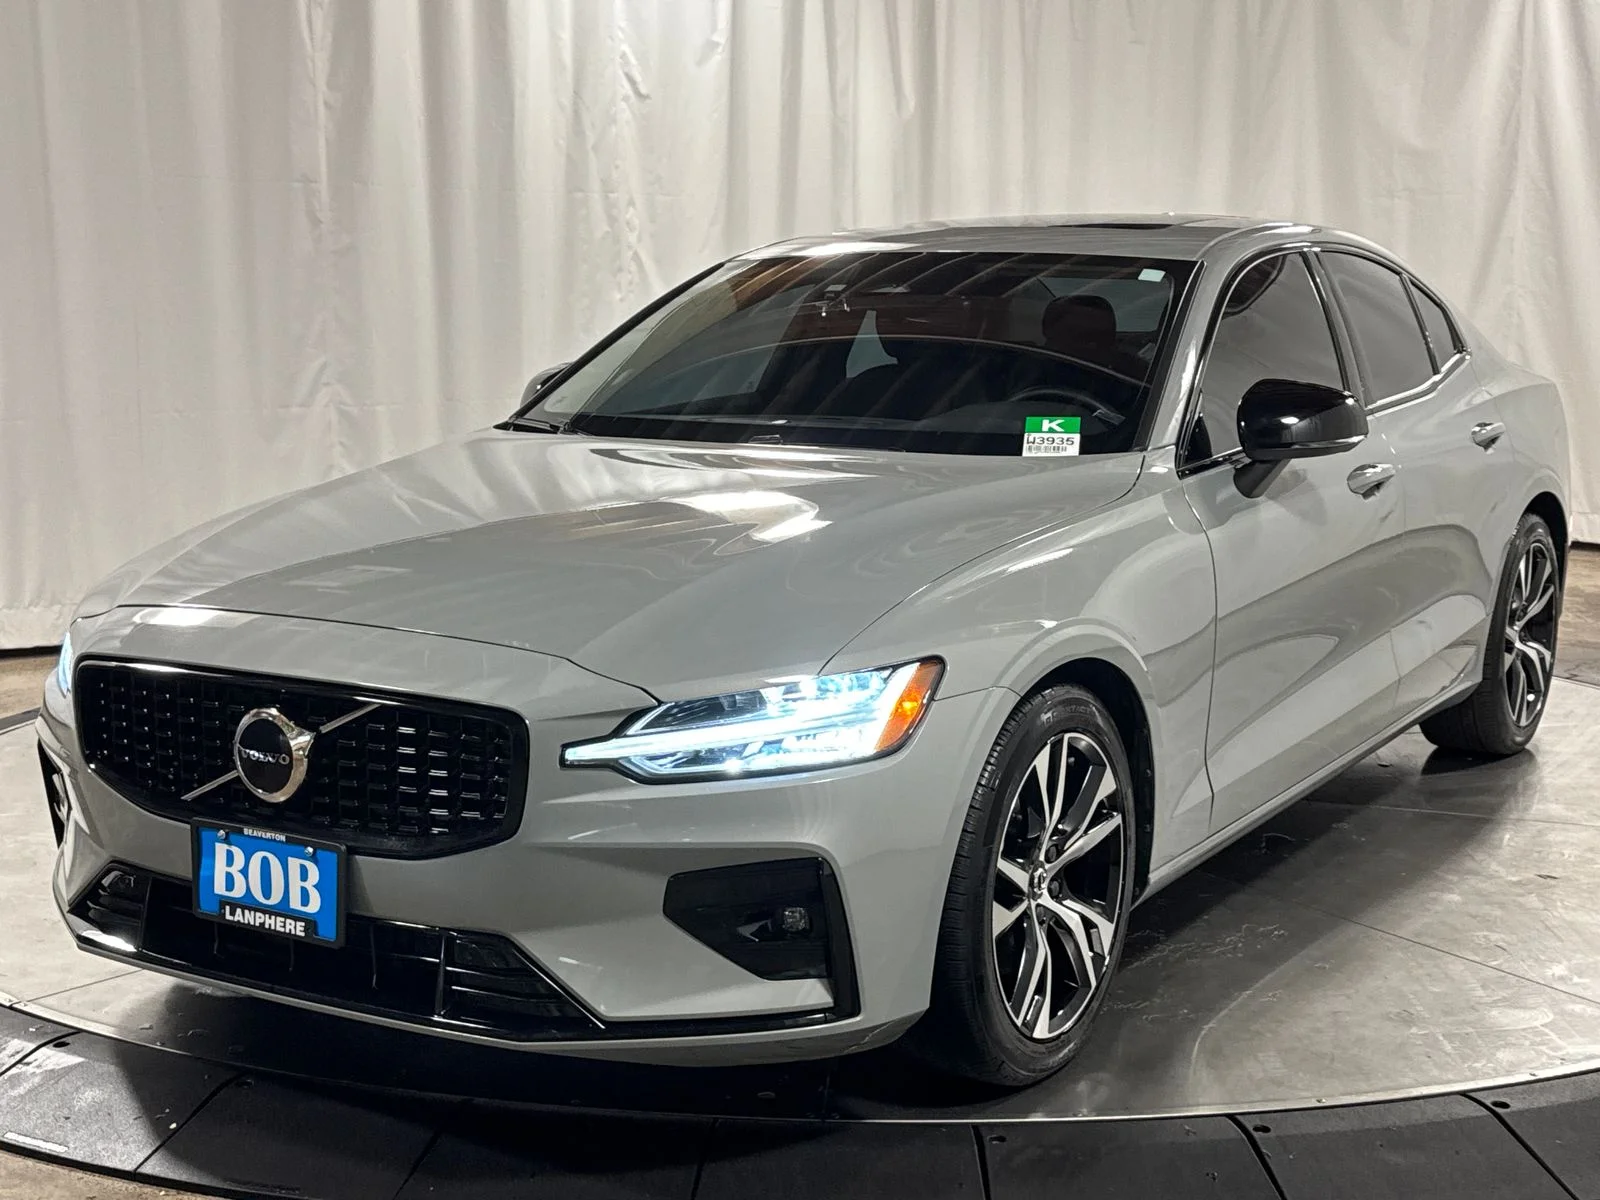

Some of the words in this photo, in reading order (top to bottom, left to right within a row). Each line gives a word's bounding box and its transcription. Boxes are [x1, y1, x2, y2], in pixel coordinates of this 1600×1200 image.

[1042, 419, 1065, 432] K
[1026, 436, 1075, 446] W3935
[243, 828, 287, 842] BEAVERTON
[214, 842, 321, 914] BOB
[225, 905, 306, 937] LANPHERE
